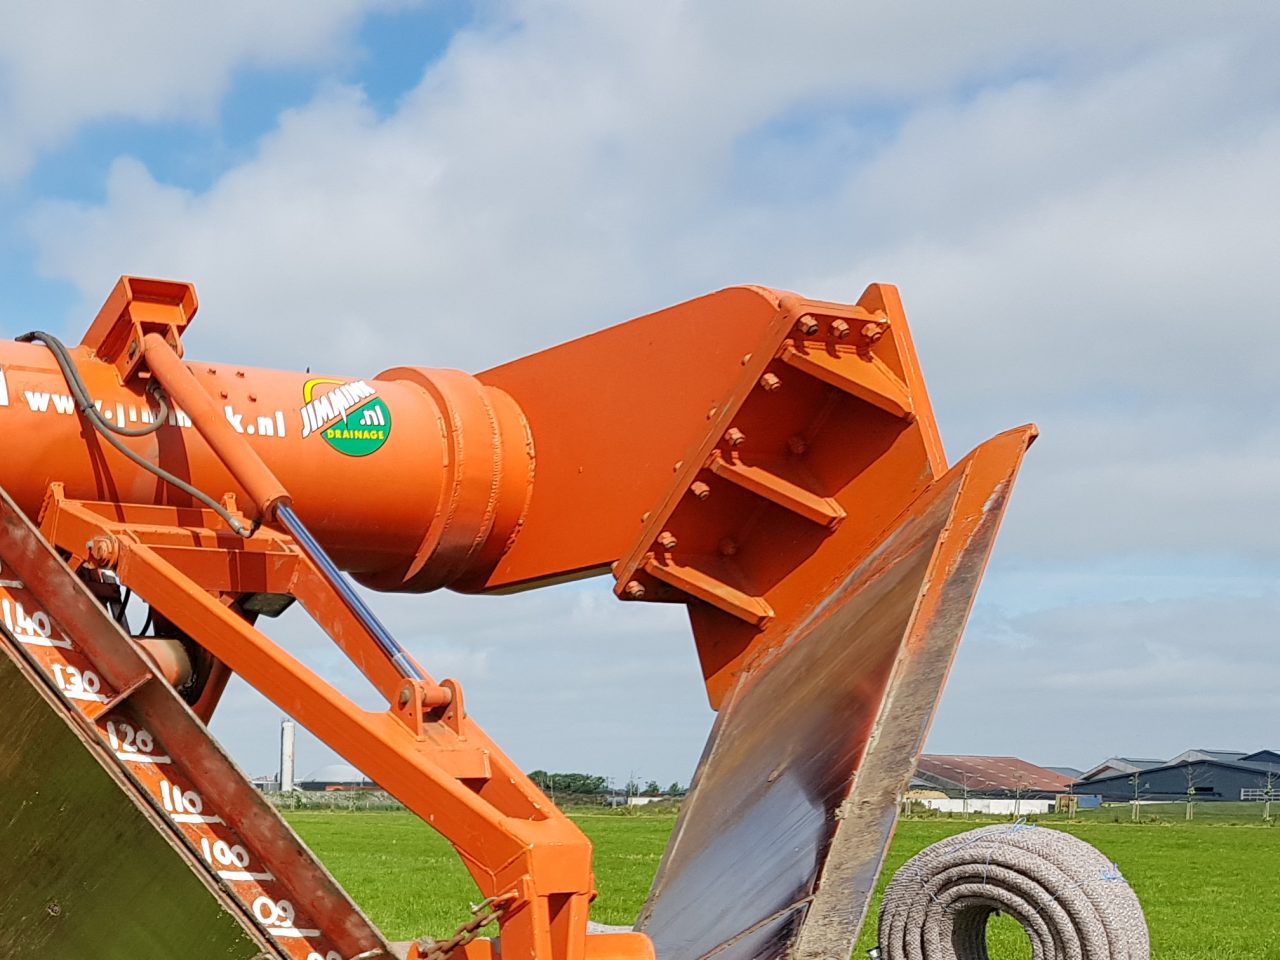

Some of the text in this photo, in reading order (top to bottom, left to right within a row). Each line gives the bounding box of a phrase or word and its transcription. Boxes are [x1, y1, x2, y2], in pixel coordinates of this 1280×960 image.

[300, 380, 377, 439] JIMMINK
[359, 404, 386, 427] .nl
[326, 429, 385, 440] DRAINAGE
[159, 780, 204, 814] 110
[200, 837, 250, 868] 100
